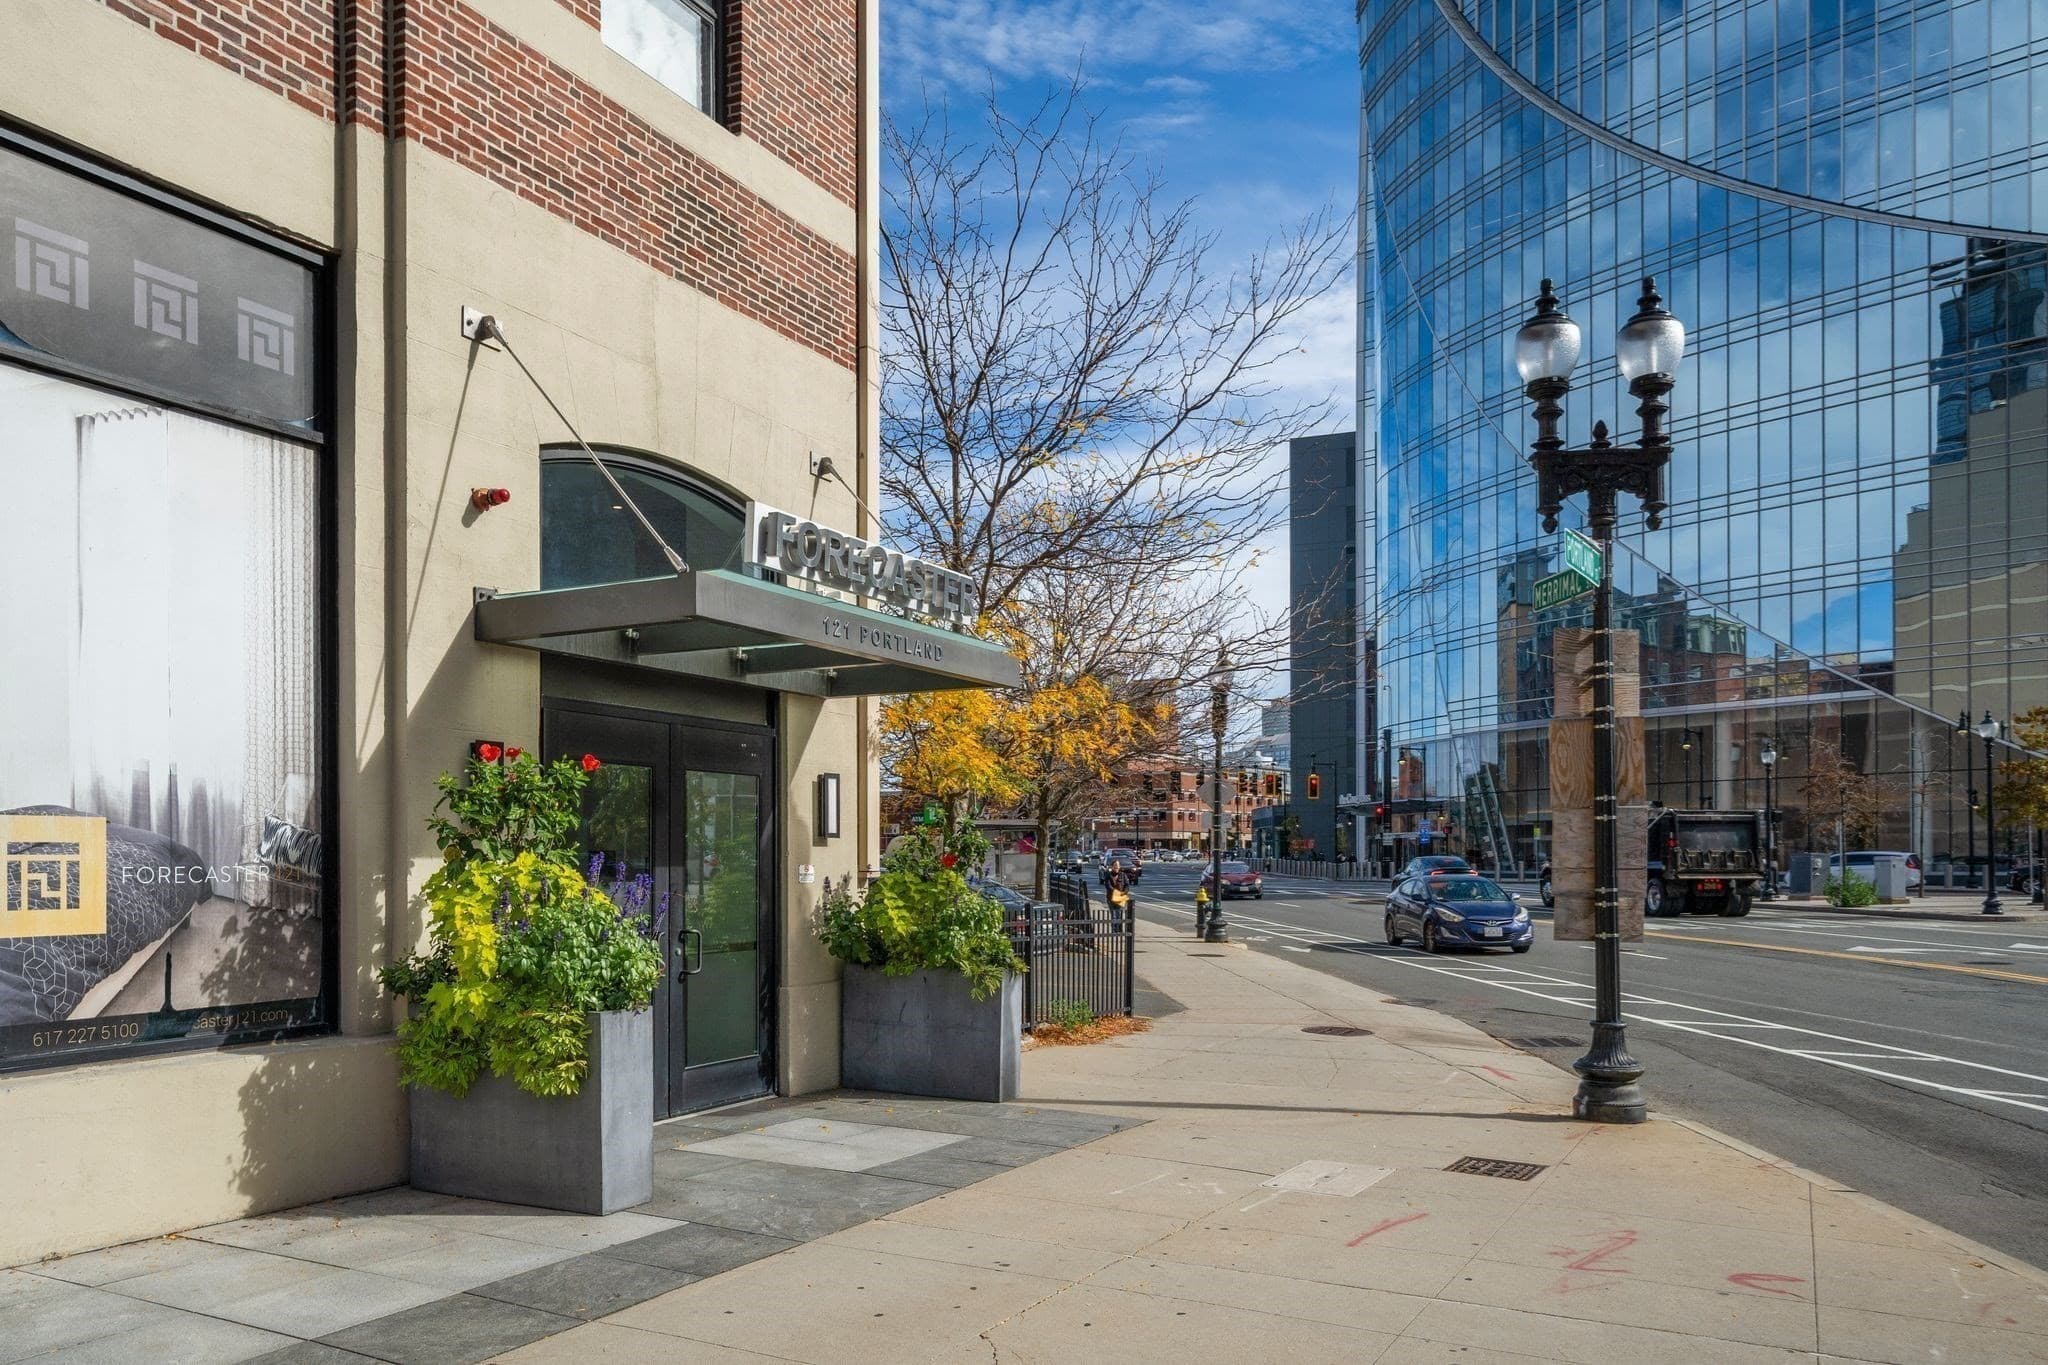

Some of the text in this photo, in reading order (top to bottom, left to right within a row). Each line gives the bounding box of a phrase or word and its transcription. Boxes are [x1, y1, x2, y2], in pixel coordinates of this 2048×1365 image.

[767, 511, 977, 618] FORECASTER
[1534, 572, 1582, 608] MERRIMAC
[822, 616, 944, 662] 121 PORTLAND
[122, 864, 302, 884] FORECASTER 121
[33, 1022, 139, 1047] 617 227 5100
